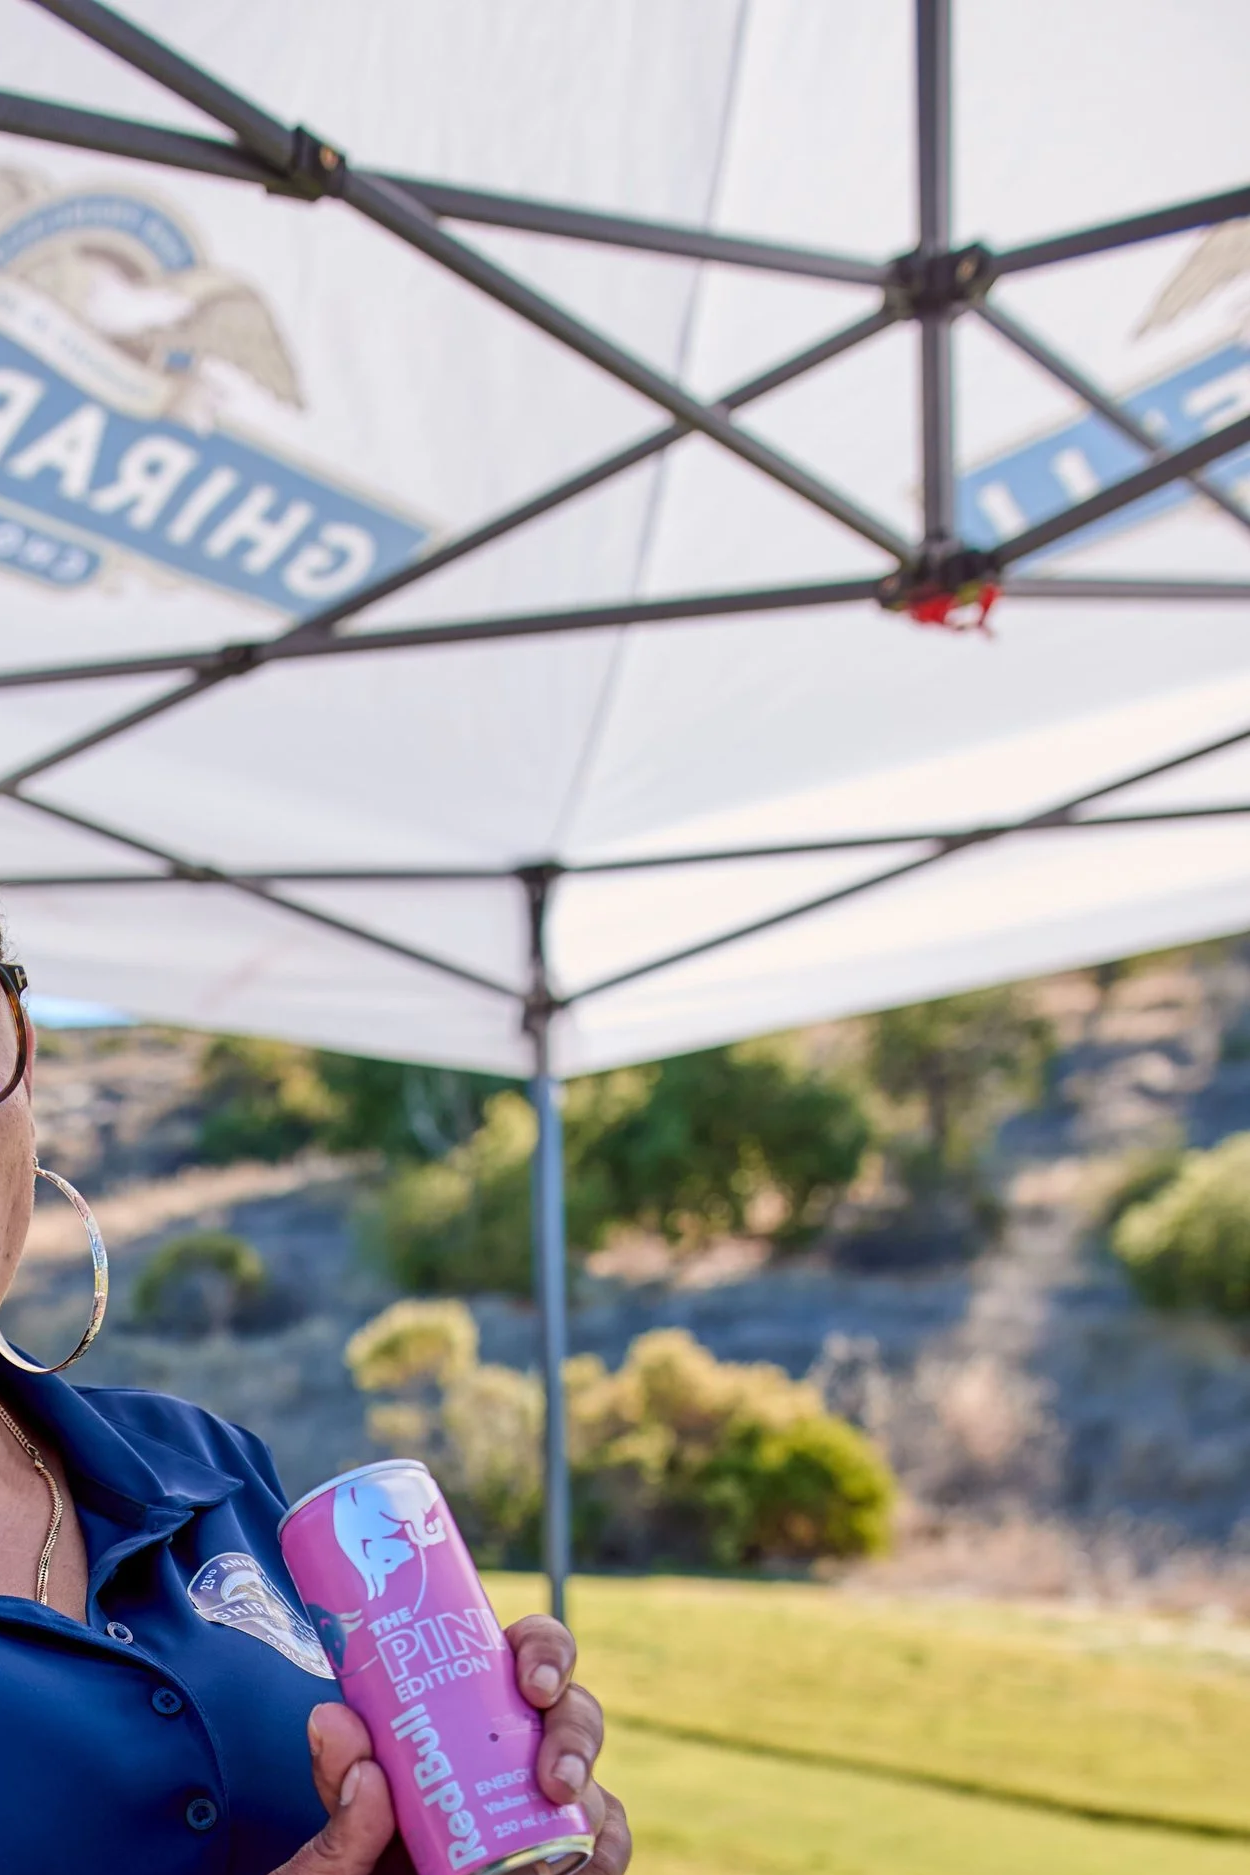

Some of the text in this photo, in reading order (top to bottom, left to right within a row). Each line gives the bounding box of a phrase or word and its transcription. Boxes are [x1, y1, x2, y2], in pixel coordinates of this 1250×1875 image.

[200, 1569, 217, 1590] 23RD
[367, 1606, 413, 1637] THE
[395, 1654, 491, 1704] EDITION
[475, 1768, 530, 1796] ENERG
